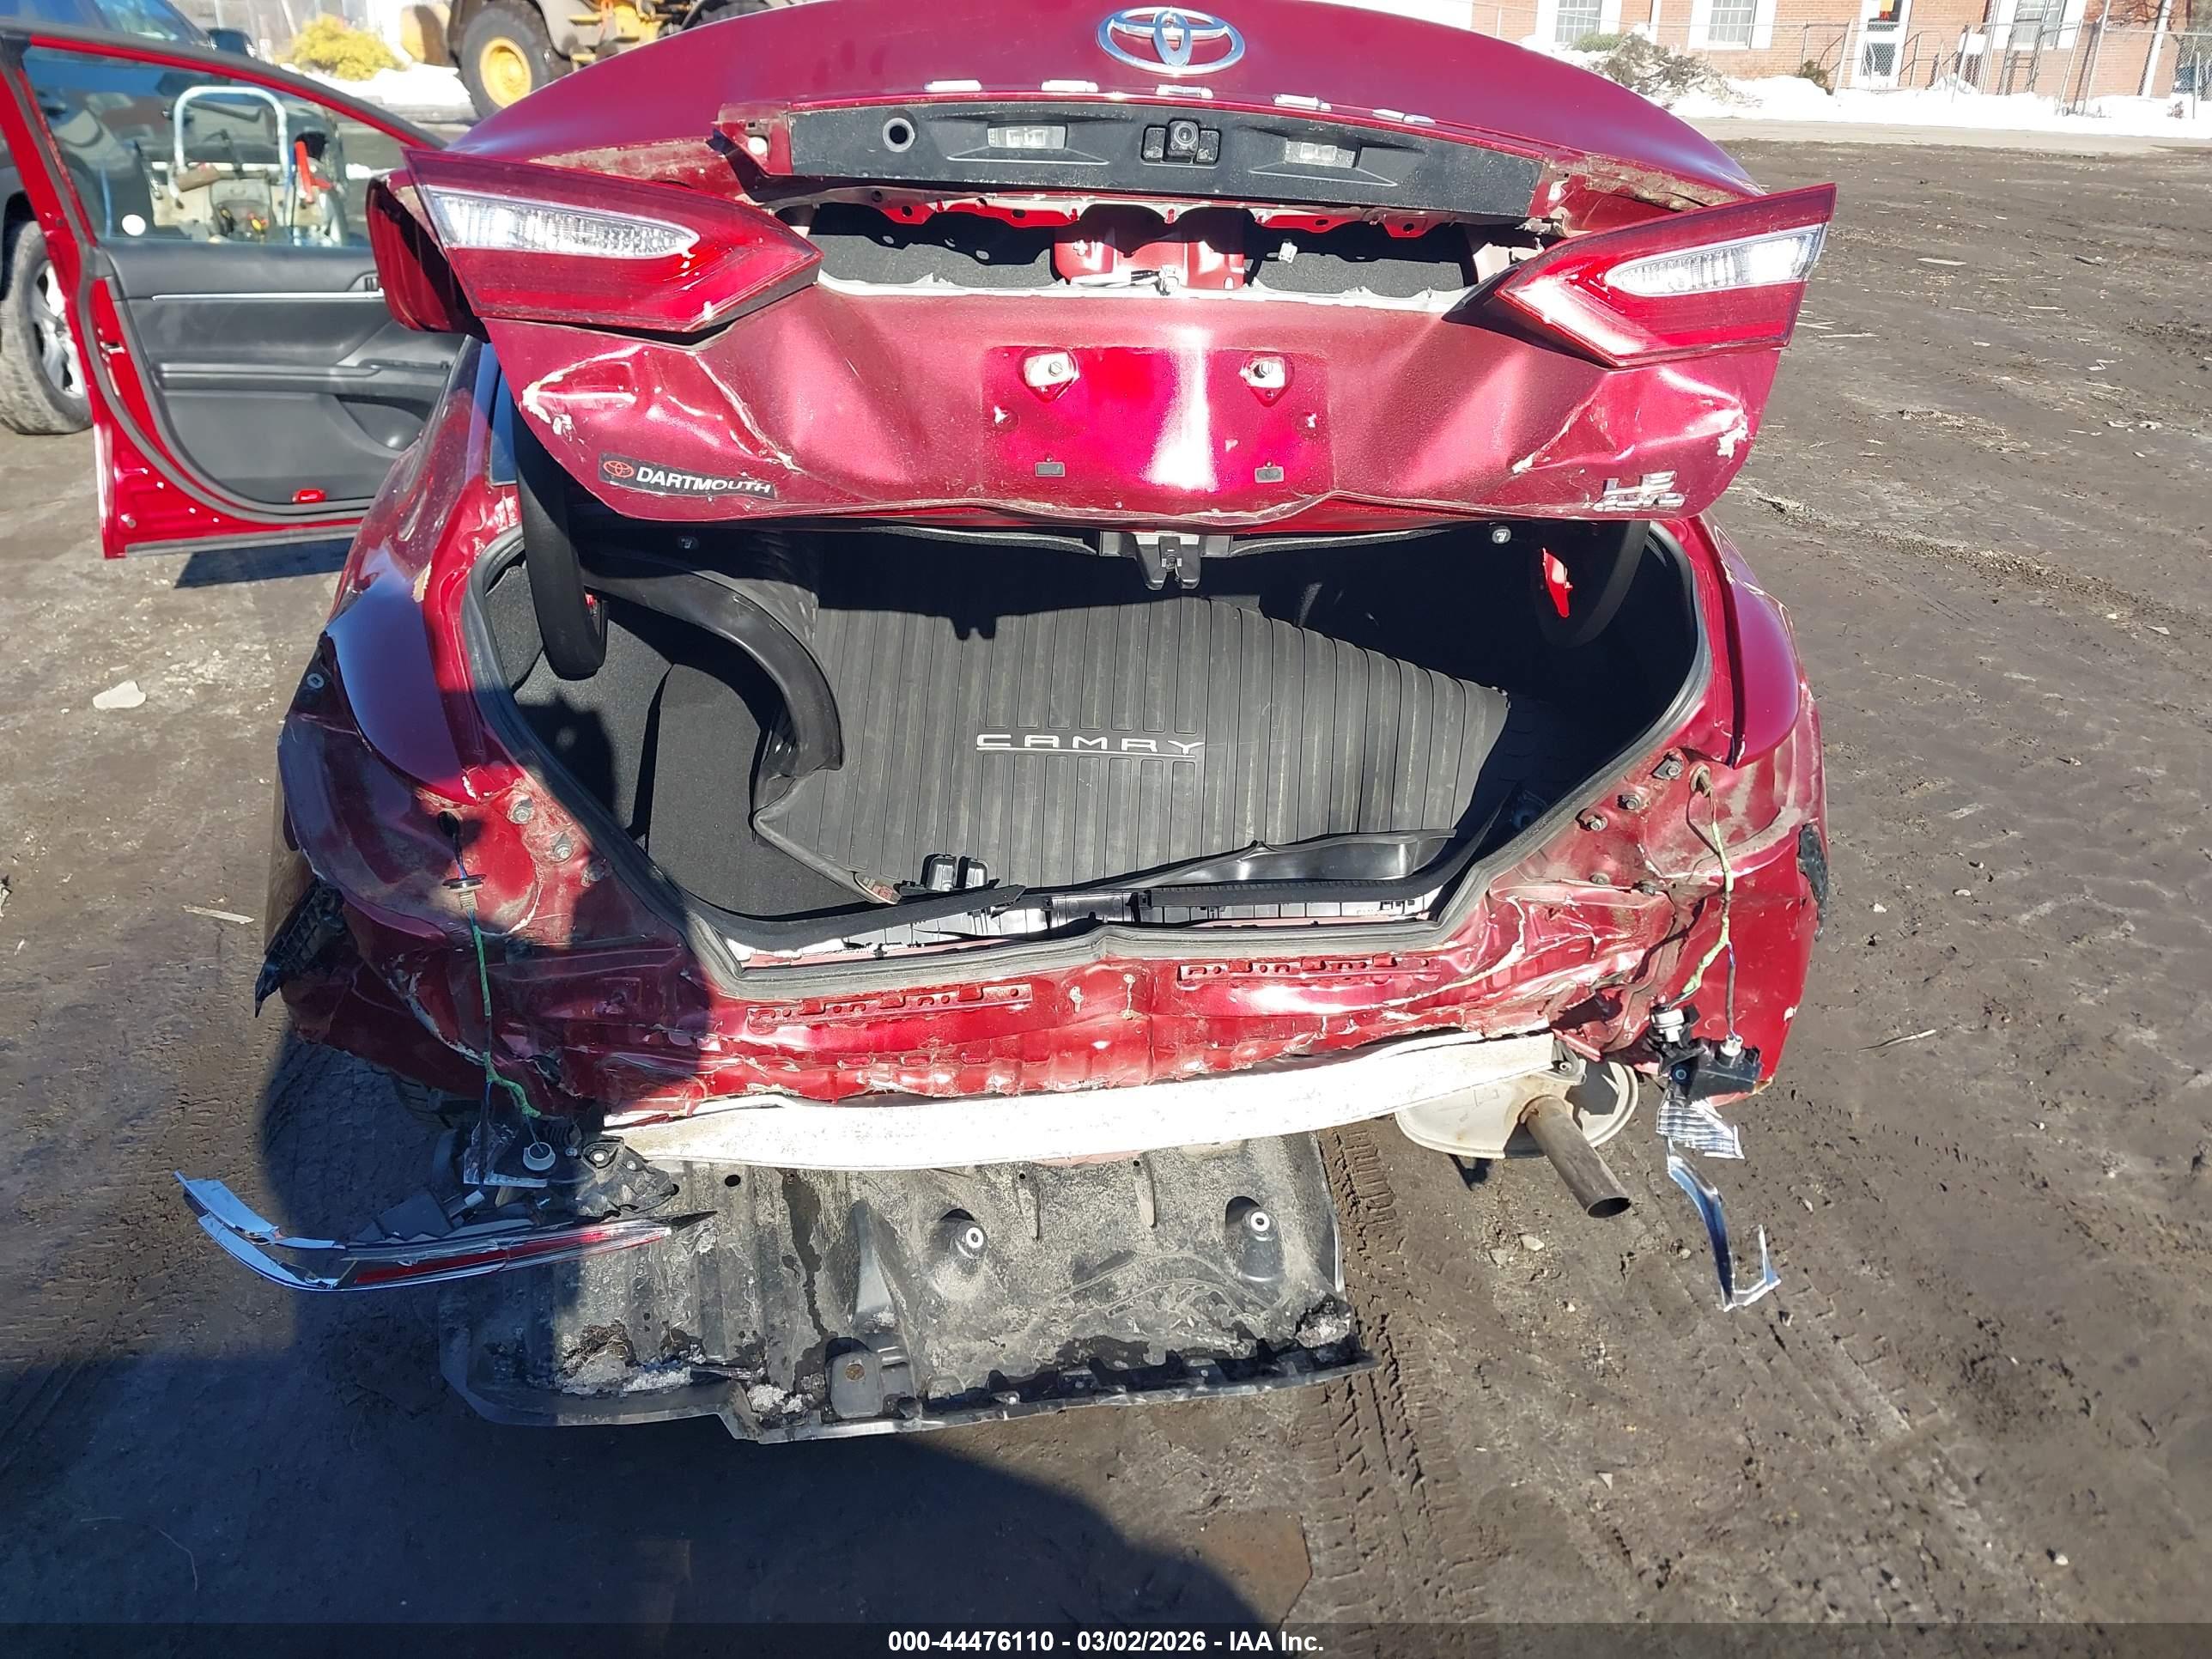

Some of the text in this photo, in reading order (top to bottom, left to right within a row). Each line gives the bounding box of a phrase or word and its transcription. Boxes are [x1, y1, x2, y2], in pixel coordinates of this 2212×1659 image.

[636, 466, 770, 493] DARTMOUTH
[1602, 470, 1678, 495] LE
[975, 733, 1205, 756] CAMRY
